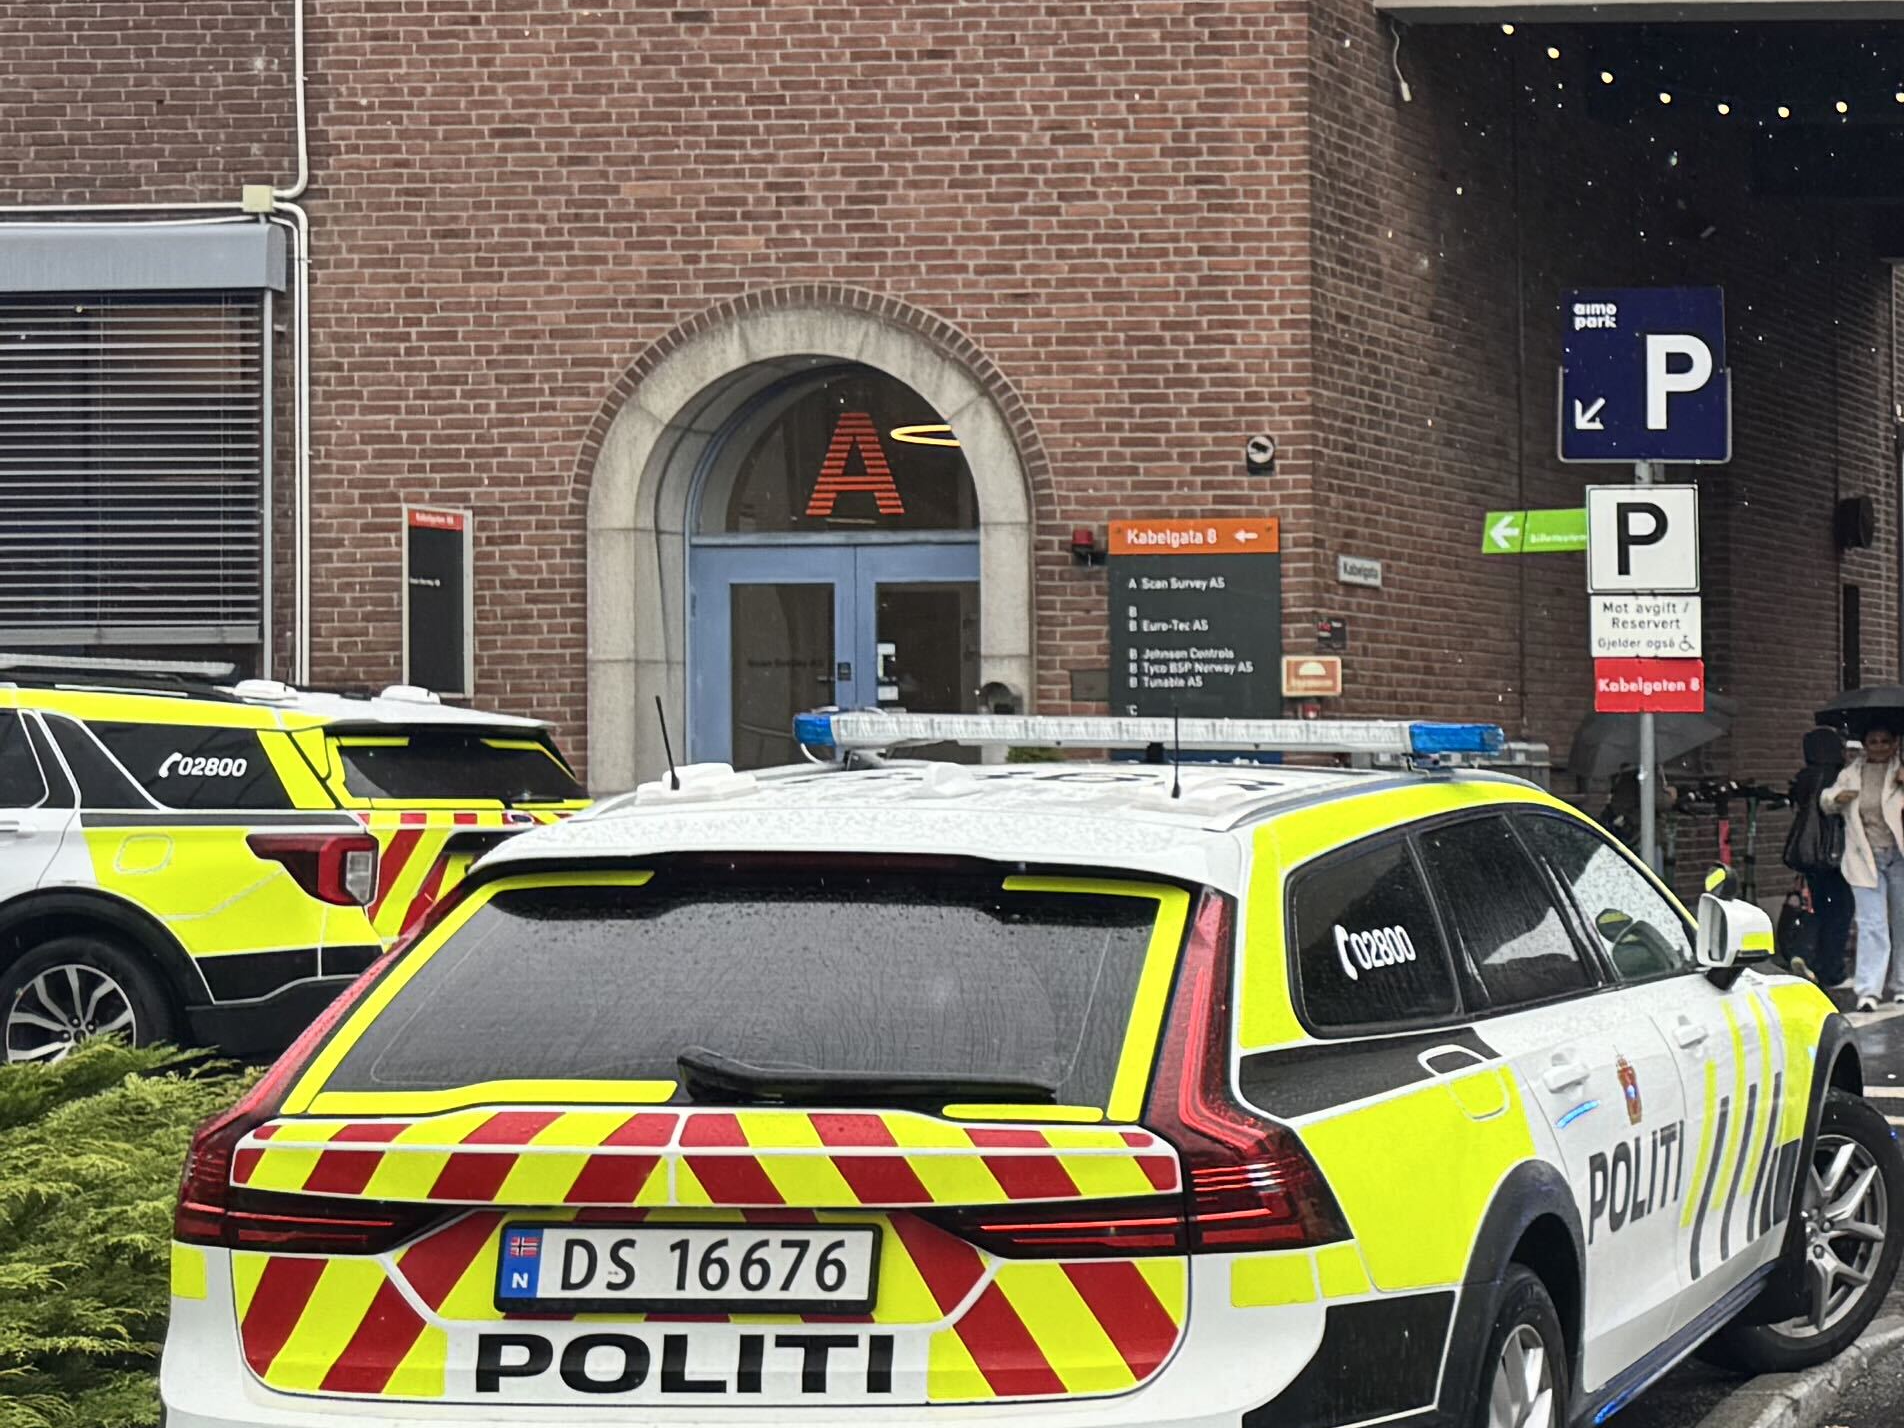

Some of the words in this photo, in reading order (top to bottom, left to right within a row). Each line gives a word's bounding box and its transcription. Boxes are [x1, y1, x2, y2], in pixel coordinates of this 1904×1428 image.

[1573, 303, 1617, 316] aimo
[1573, 316, 1617, 331] park
[1646, 334, 1713, 430] P
[805, 412, 904, 515] A
[1127, 529, 1204, 548] Kabelgata
[1207, 528, 1218, 544] 8
[1616, 502, 1669, 576] P
[1128, 578, 1137, 589] A
[1141, 578, 1168, 590] Scan
[1170, 577, 1207, 592] Survey
[1209, 577, 1225, 589] AS
[1603, 602, 1629, 614] Mot
[1635, 602, 1677, 618] avgift
[1193, 619, 1209, 632] AS
[1612, 617, 1681, 630] Reservert
[1598, 637, 1641, 651] Gjelder
[1646, 637, 1675, 651] også
[1142, 648, 1188, 660] Johnson
[1238, 661, 1253, 673] AS
[1187, 675, 1203, 688] AS
[1599, 677, 1687, 695] Kabelgaten
[1690, 678, 1700, 691] 8
[177, 755, 248, 778] 02800
[1351, 926, 1416, 971] 02800
[1587, 1120, 1686, 1246] POLITI
[560, 1237, 638, 1293] DS
[669, 1237, 849, 1293] 16676
[511, 1271, 530, 1290] N
[475, 1332, 896, 1396] POLITI
